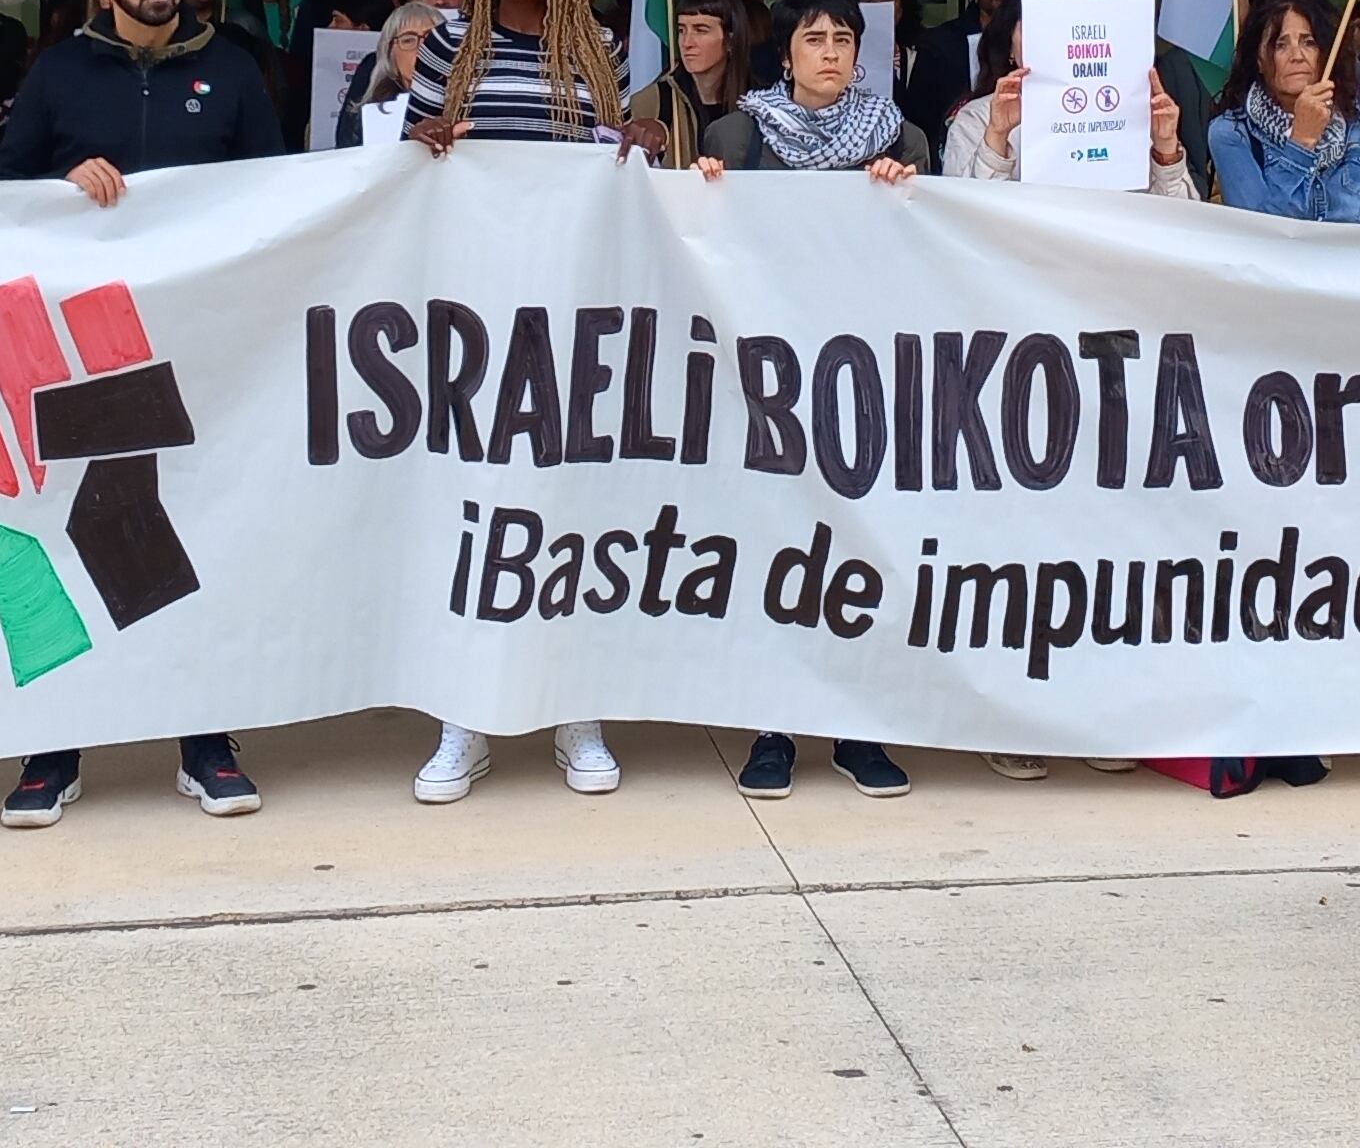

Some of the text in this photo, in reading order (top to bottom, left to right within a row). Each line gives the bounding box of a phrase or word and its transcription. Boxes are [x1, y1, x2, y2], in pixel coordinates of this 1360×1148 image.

[1071, 25, 1106, 40] ISRAELI
[1067, 43, 1111, 59] BOIKOTA
[1073, 63, 1108, 78] ORAIN!
[736, 329, 1224, 500] BOIKOTA
[450, 500, 737, 623] ¡Basta
[763, 521, 883, 639] de
